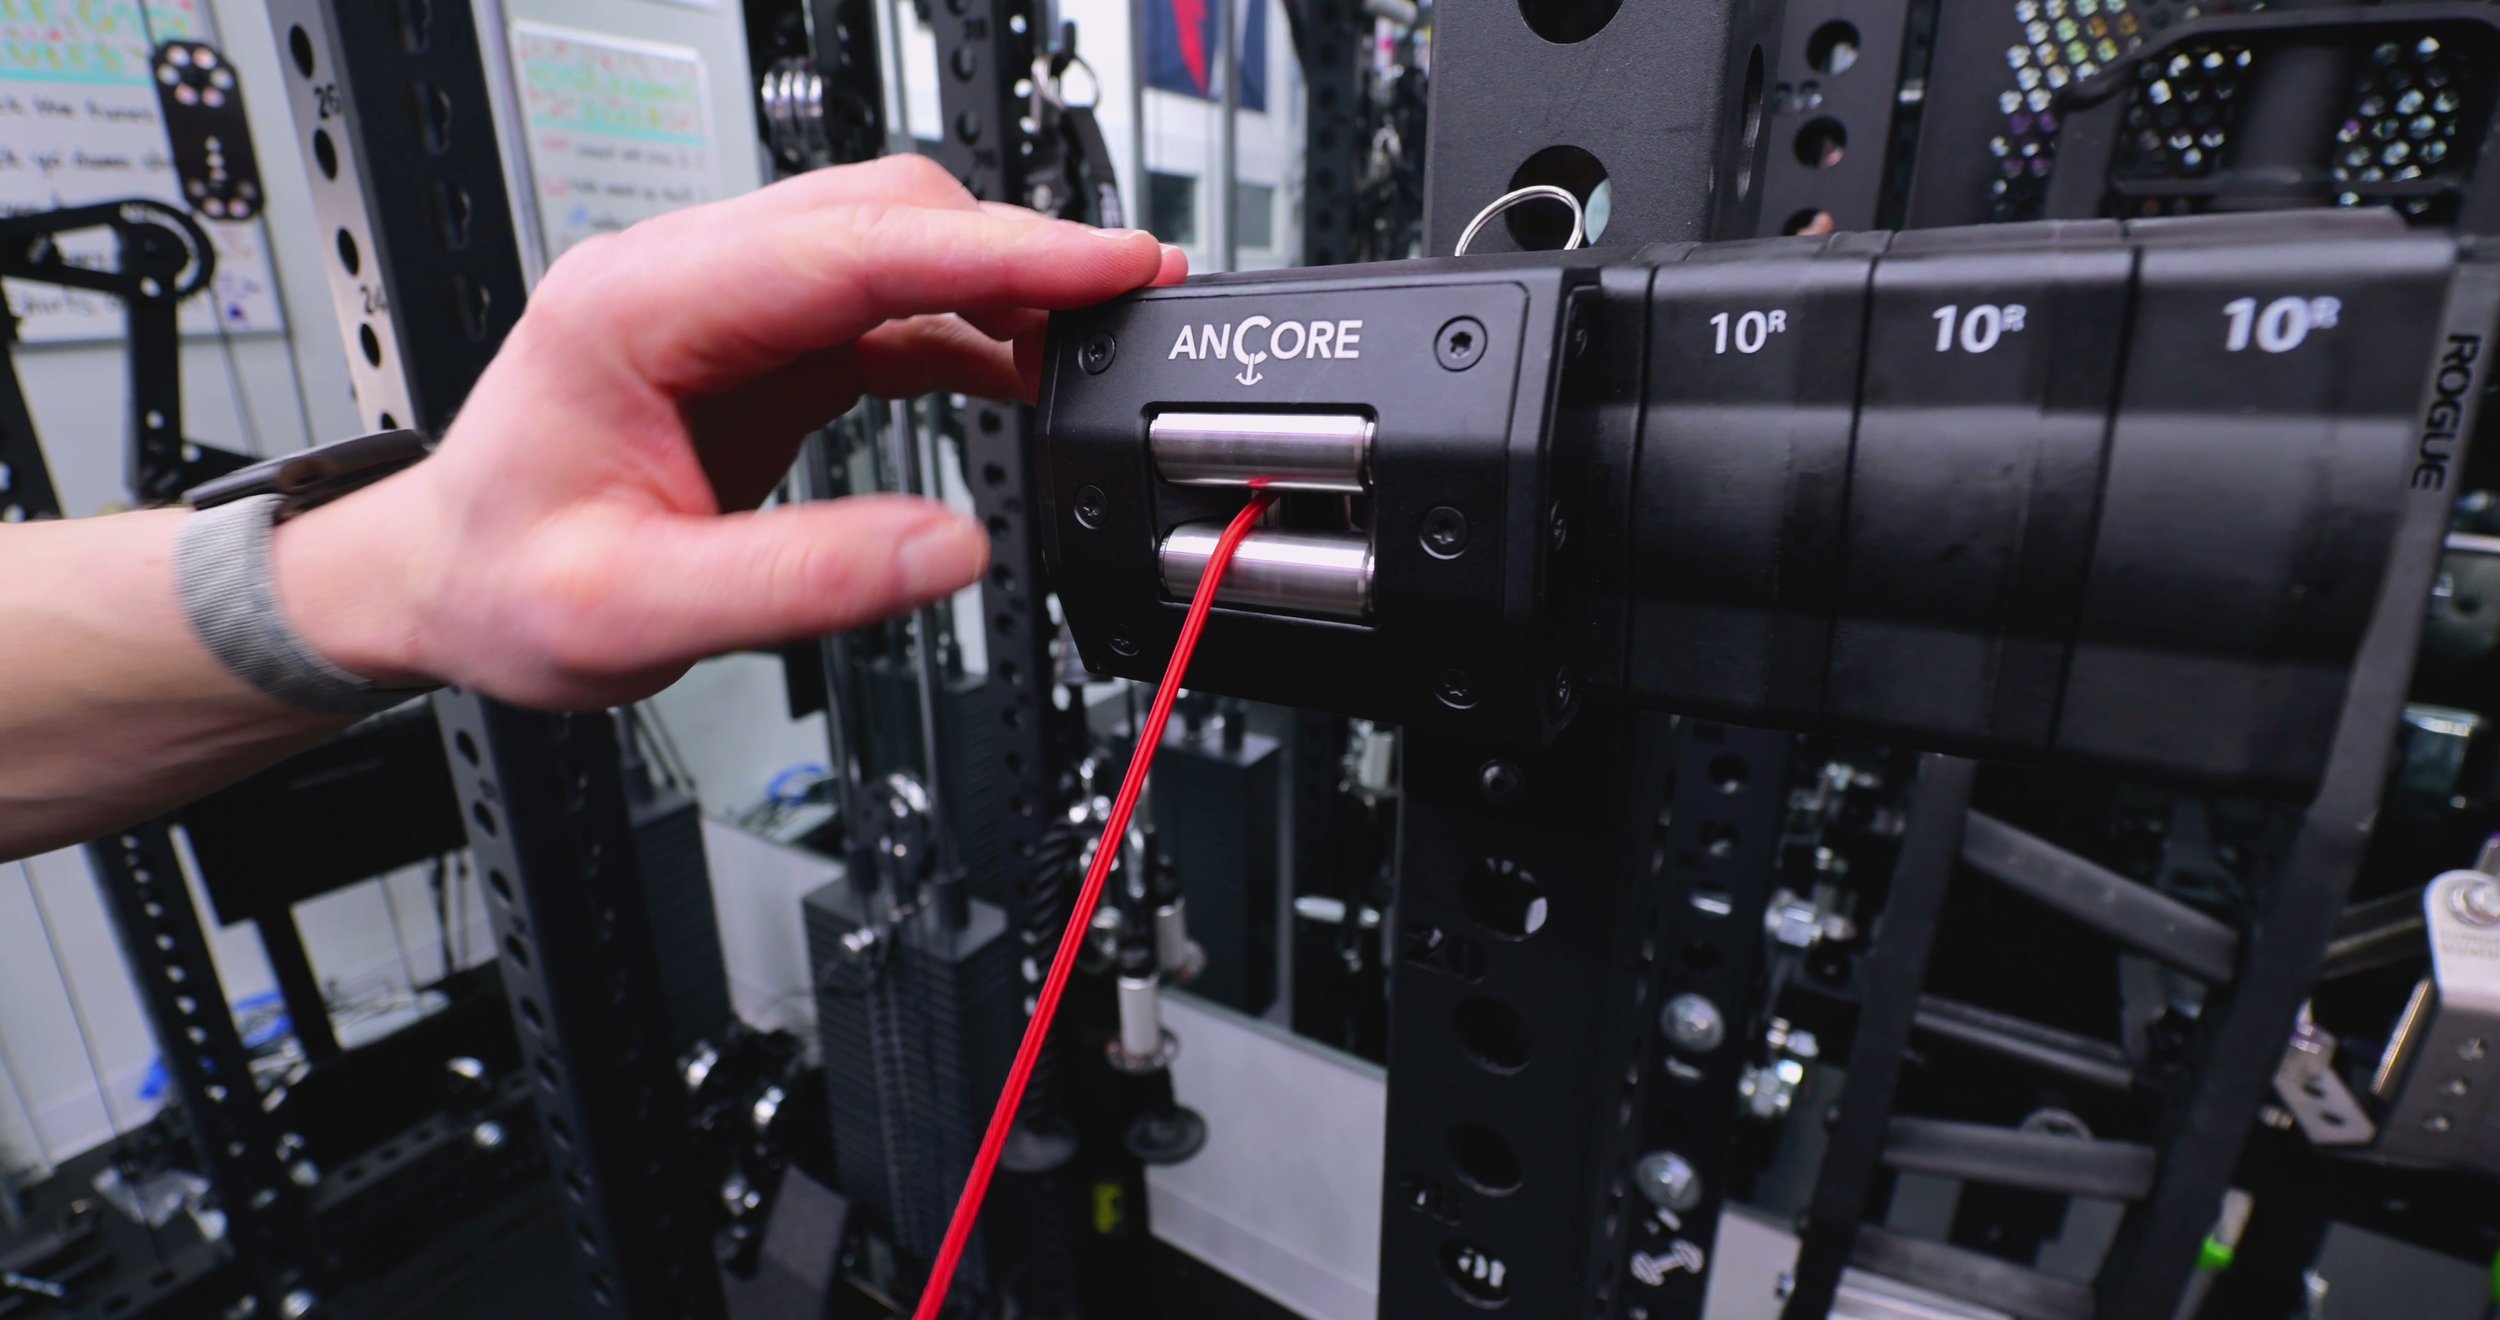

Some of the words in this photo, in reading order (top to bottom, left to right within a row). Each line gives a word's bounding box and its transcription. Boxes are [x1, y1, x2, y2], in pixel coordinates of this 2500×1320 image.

[1168, 315, 1363, 386] ANCORE
[1709, 309, 1787, 354] 10R
[2410, 334, 2482, 491] ROGUE
